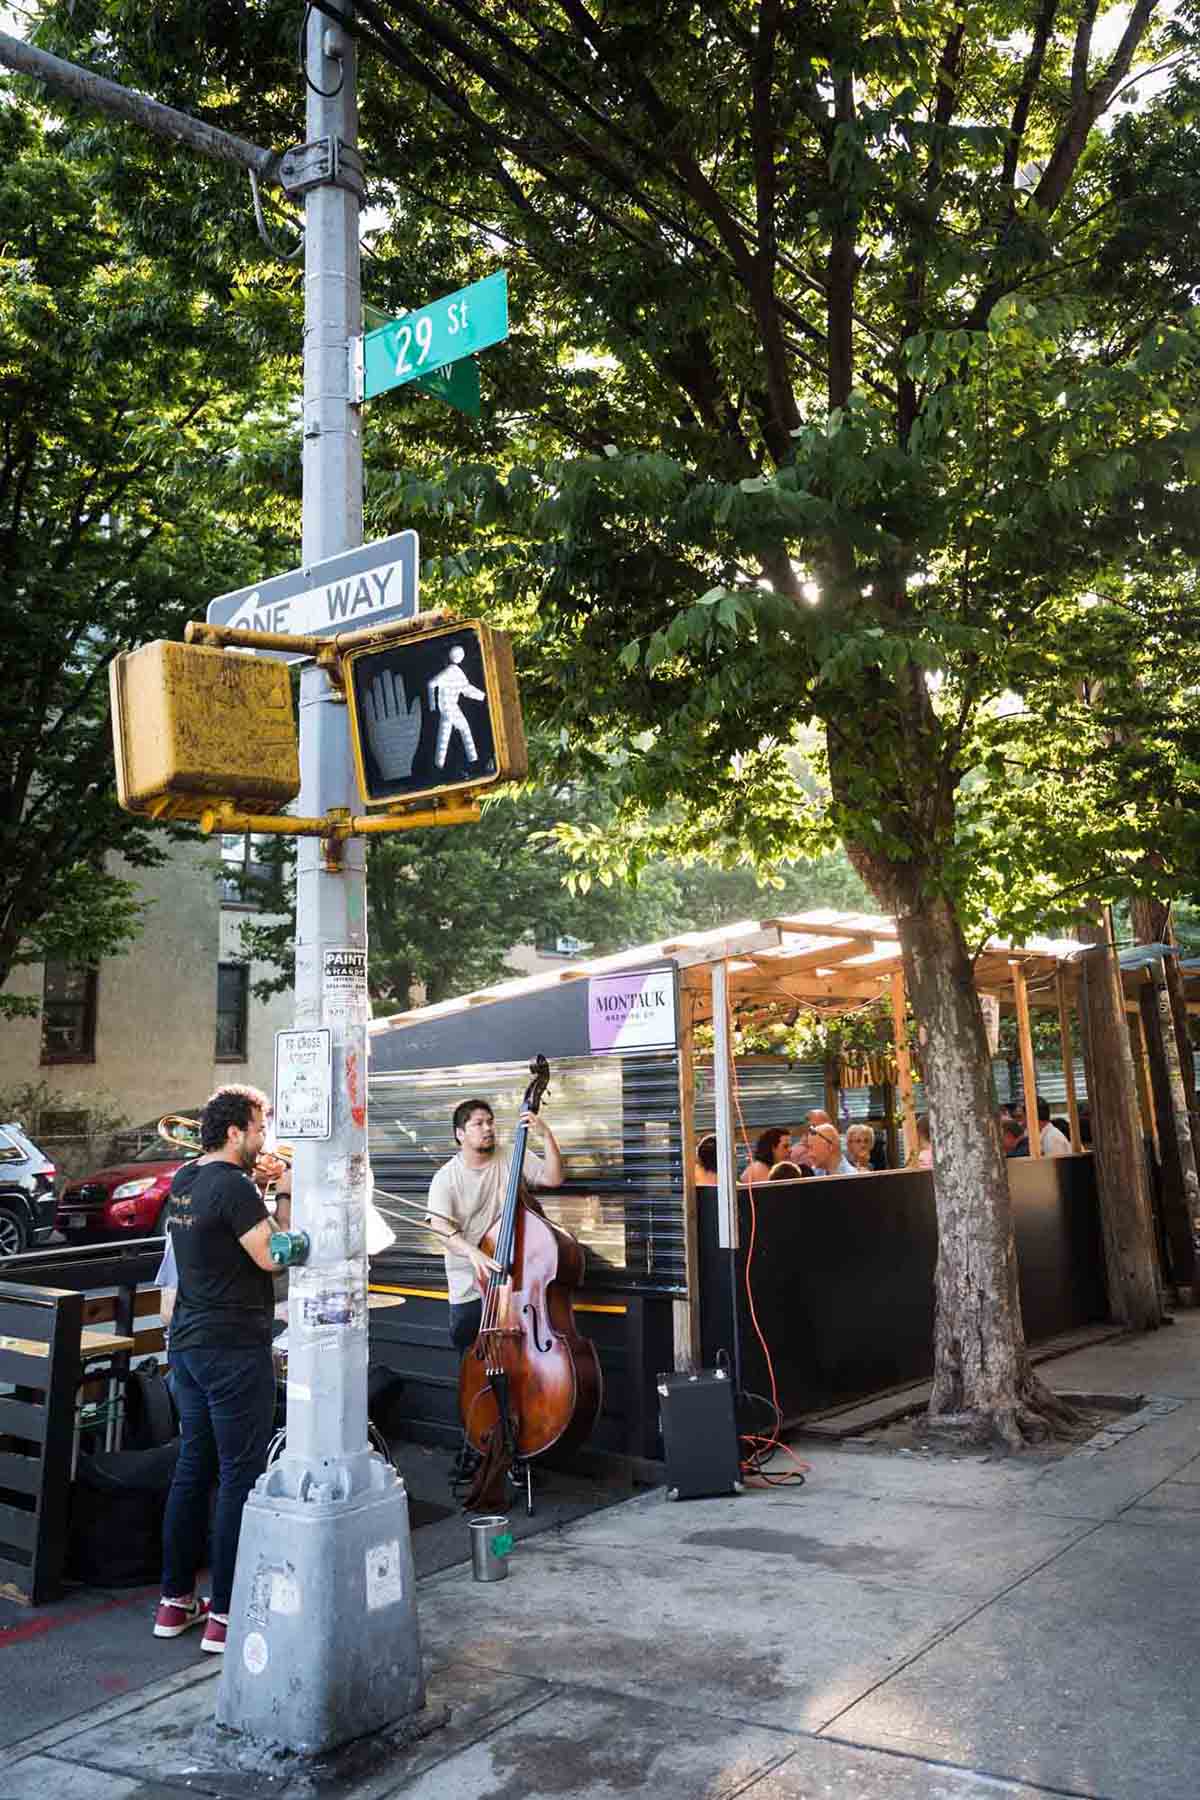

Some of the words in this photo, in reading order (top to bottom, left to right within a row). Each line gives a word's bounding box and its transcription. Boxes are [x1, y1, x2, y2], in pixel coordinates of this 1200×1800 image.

[394, 316, 433, 377] 29
[447, 299, 470, 335] St
[326, 566, 395, 621] WAY
[596, 990, 666, 1012] MONTAUK
